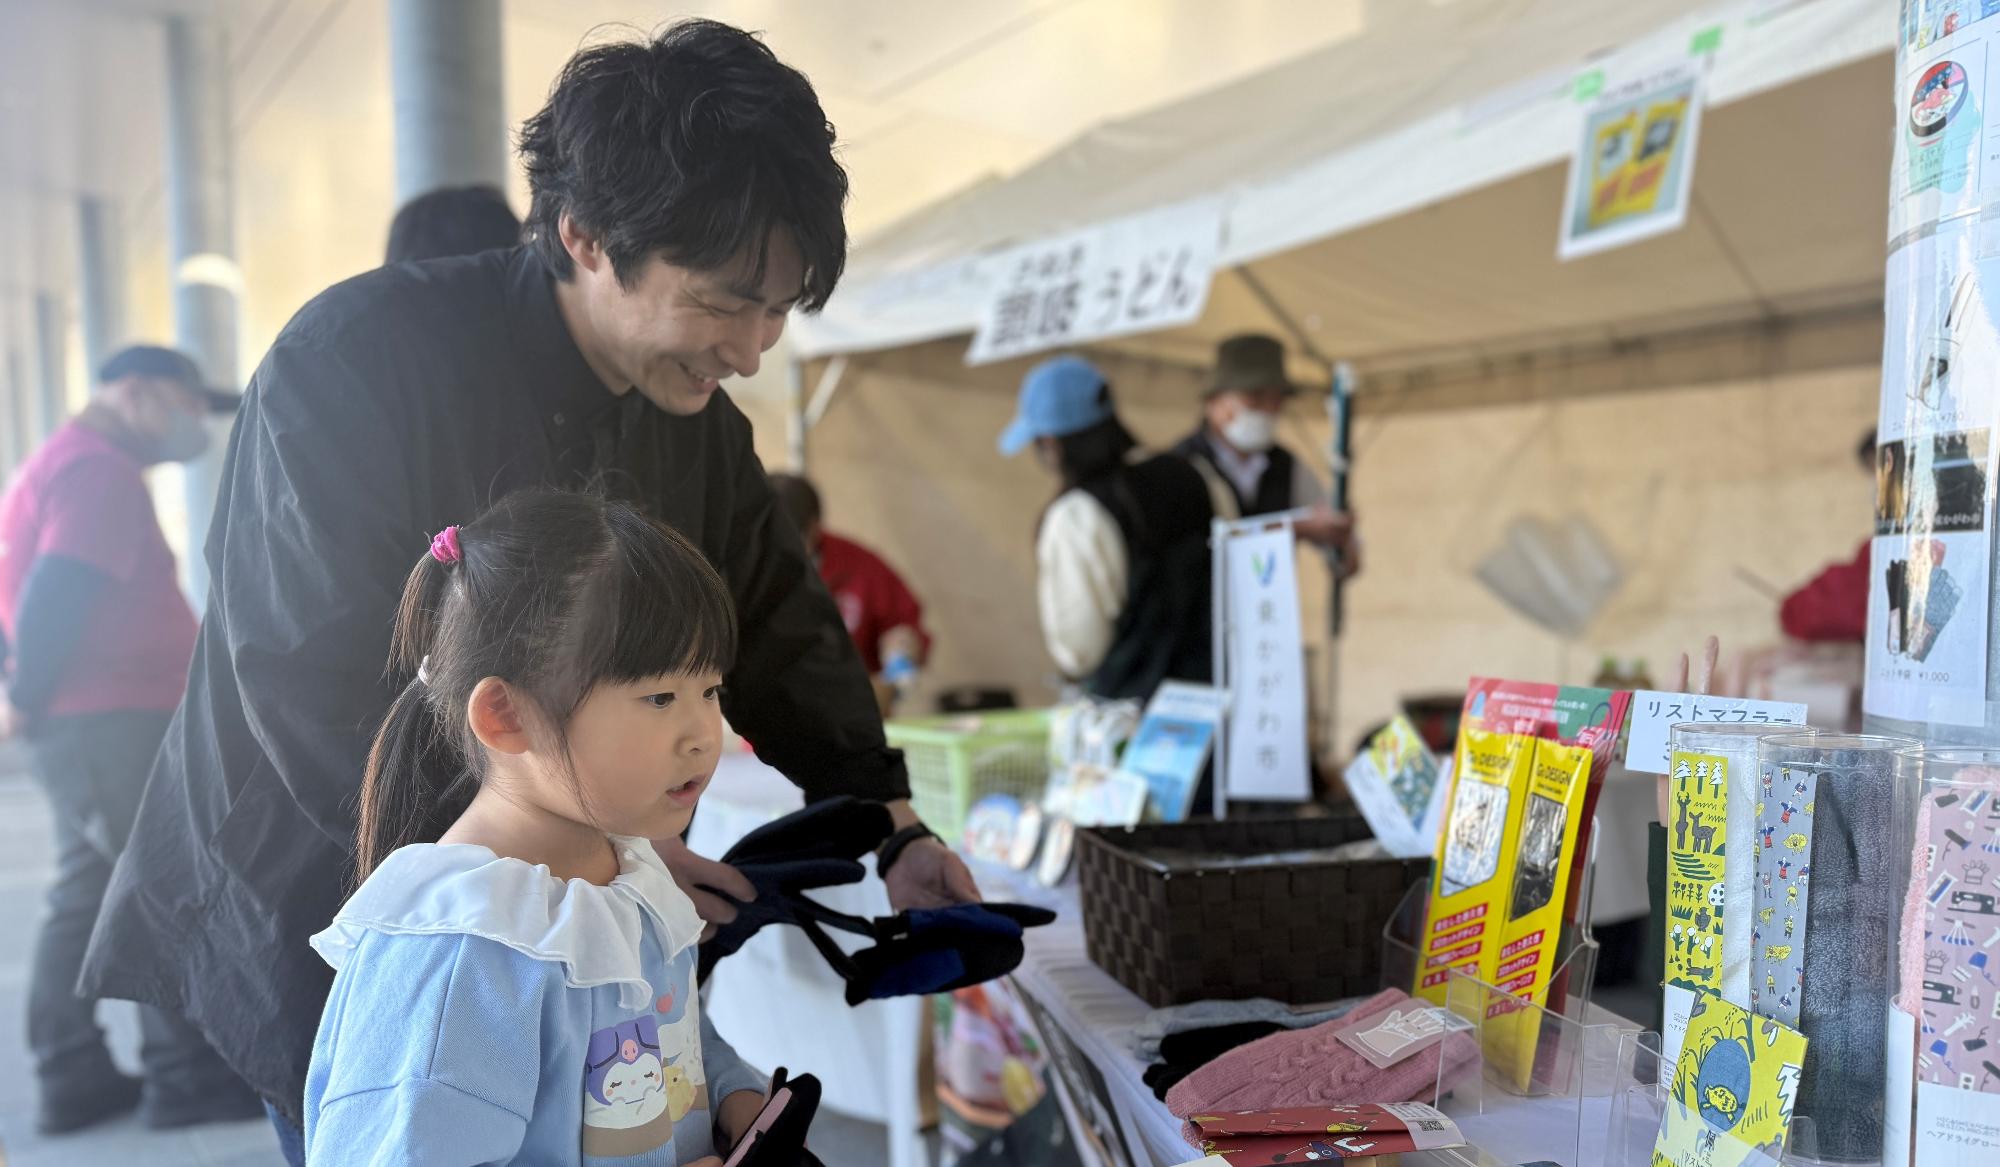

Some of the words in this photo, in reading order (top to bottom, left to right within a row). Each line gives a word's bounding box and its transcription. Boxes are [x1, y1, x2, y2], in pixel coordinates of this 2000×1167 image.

[1648, 700, 1792, 722] リストマフラー
